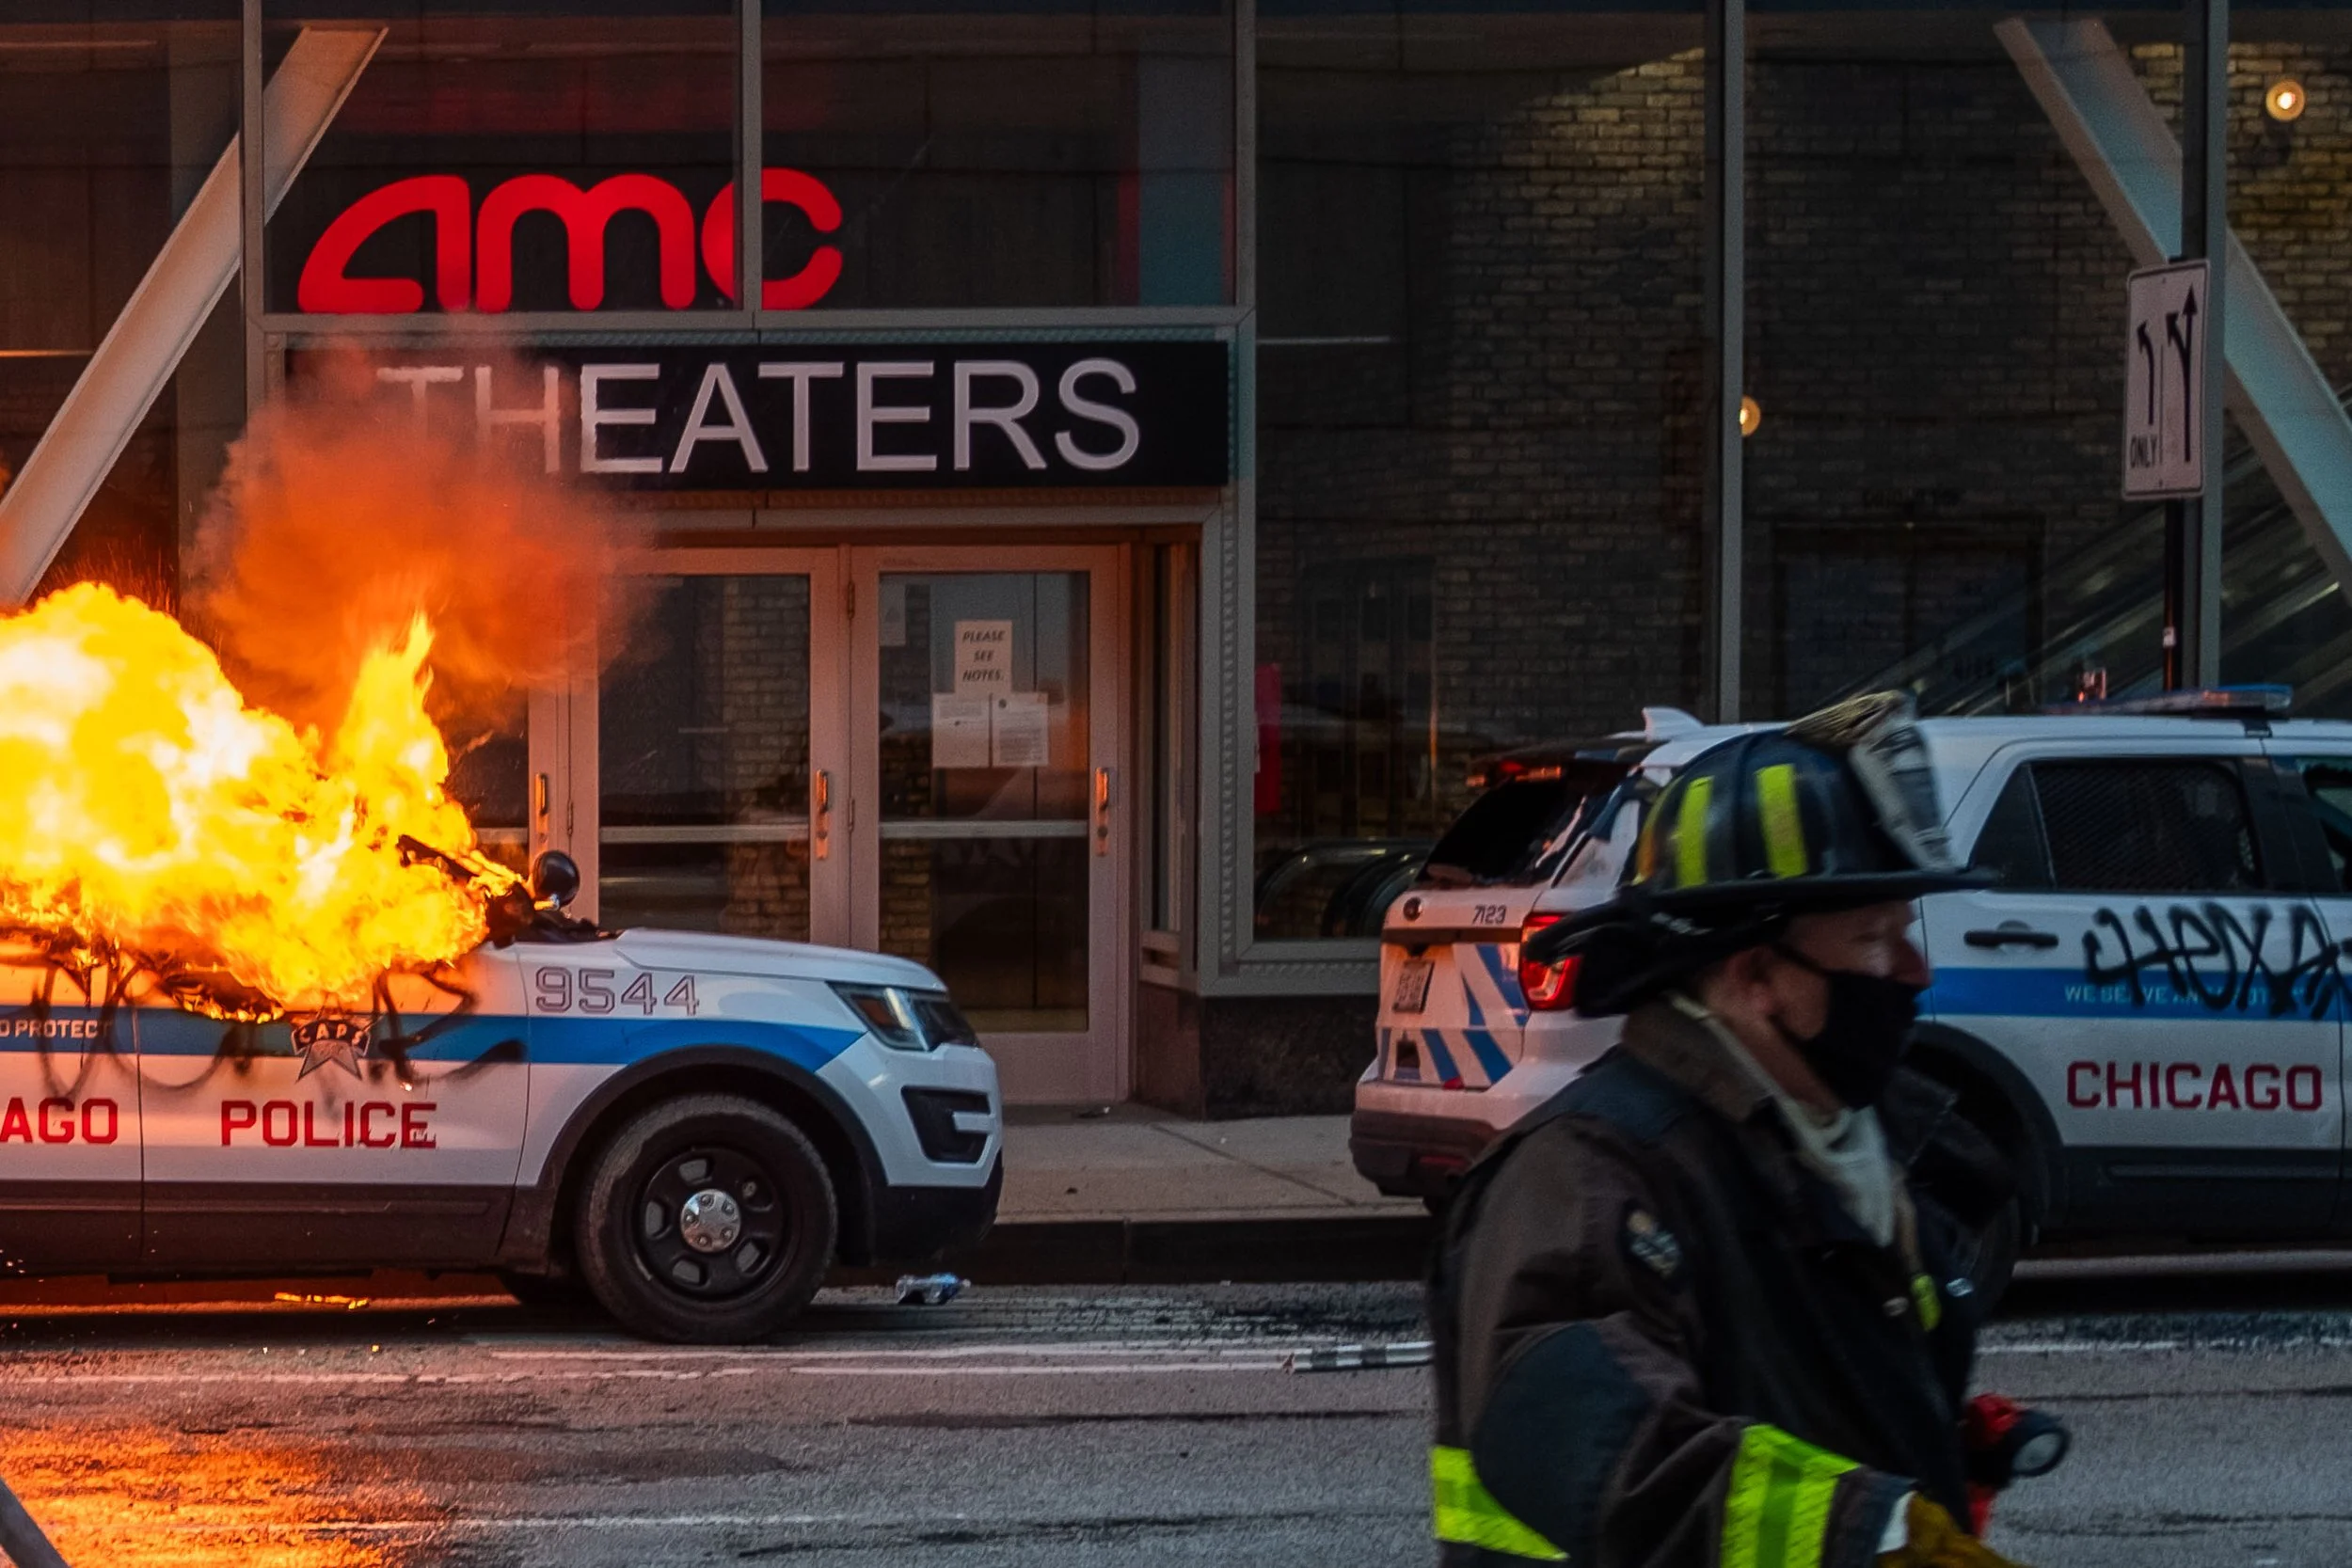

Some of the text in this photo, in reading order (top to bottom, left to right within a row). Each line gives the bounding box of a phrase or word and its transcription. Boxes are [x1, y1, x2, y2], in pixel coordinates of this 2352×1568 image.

[376, 357, 1140, 472] THEATERS
[2129, 434, 2157, 468] ONLY
[961, 629, 1006, 644] PLEASE
[973, 649, 994, 662] SEE
[1471, 903, 1507, 925] 7123
[535, 966, 700, 1017] 9544
[2064, 984, 2096, 1004] WE
[298, 1022, 364, 1046] CAPS
[2066, 1060, 2323, 1112] CHICAGO
[220, 1100, 437, 1150] POLICE
